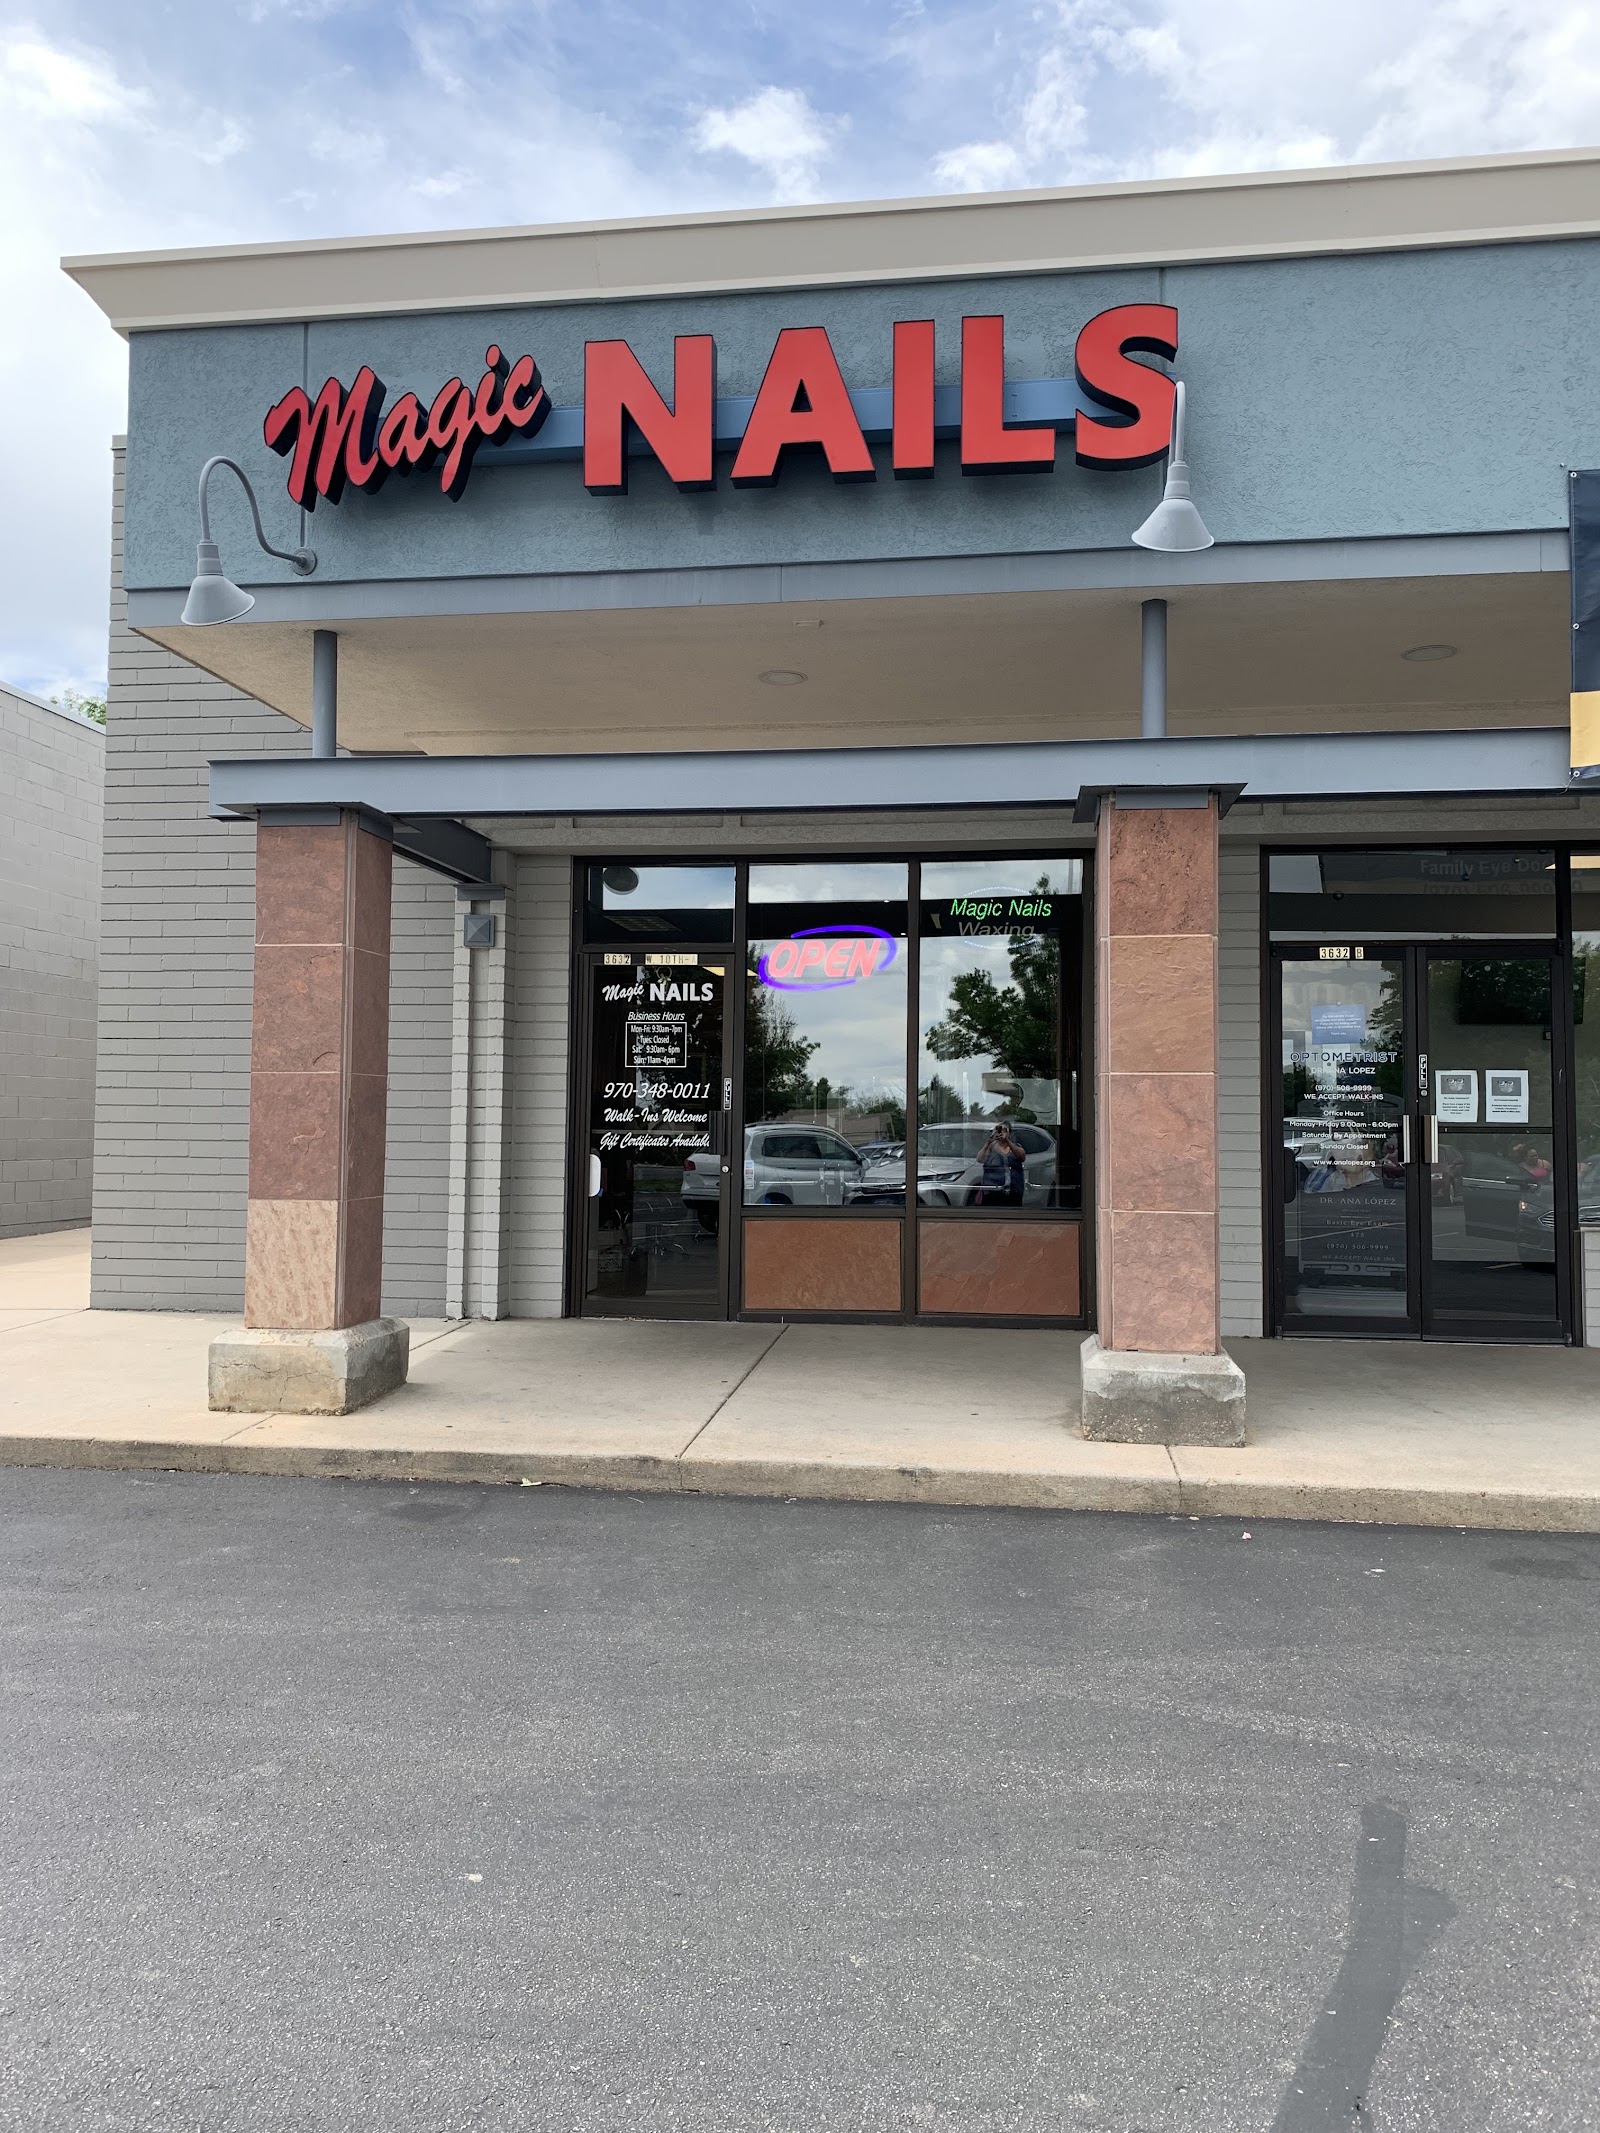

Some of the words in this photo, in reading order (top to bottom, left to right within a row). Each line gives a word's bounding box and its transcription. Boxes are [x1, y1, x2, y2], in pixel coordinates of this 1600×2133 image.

[264, 344, 553, 514] Magic
[584, 303, 1179, 497] NAILS
[950, 898, 1003, 921] Magic
[1008, 898, 1052, 917] Nails
[958, 922, 1035, 940] Waxing
[605, 954, 630, 965] 3632
[768, 938, 882, 978] OPEN
[1321, 948, 1349, 959] 3632
[1356, 948, 1363, 958] B
[602, 983, 645, 1002] Magic
[649, 983, 714, 1001] NAILS
[627, 1011, 661, 1021] Business
[662, 1011, 686, 1021] Hours
[653, 1035, 670, 1044] Closed
[1290, 1051, 1398, 1063] OPTOMETRIST
[1348, 1067, 1376, 1075] LOPEZ
[603, 1082, 711, 1099] 970-348-0011
[603, 1107, 660, 1123] Walk-Ins
[661, 1108, 708, 1123] Welcome
[600, 1131, 620, 1151] Gift
[620, 1131, 669, 1151] Certificates
[1302, 1131, 1333, 1140] Saturday
[1343, 1132, 1387, 1140] Appointment
[1320, 1143, 1346, 1151] Sunday
[1340, 1197, 1361, 1206] ANA
